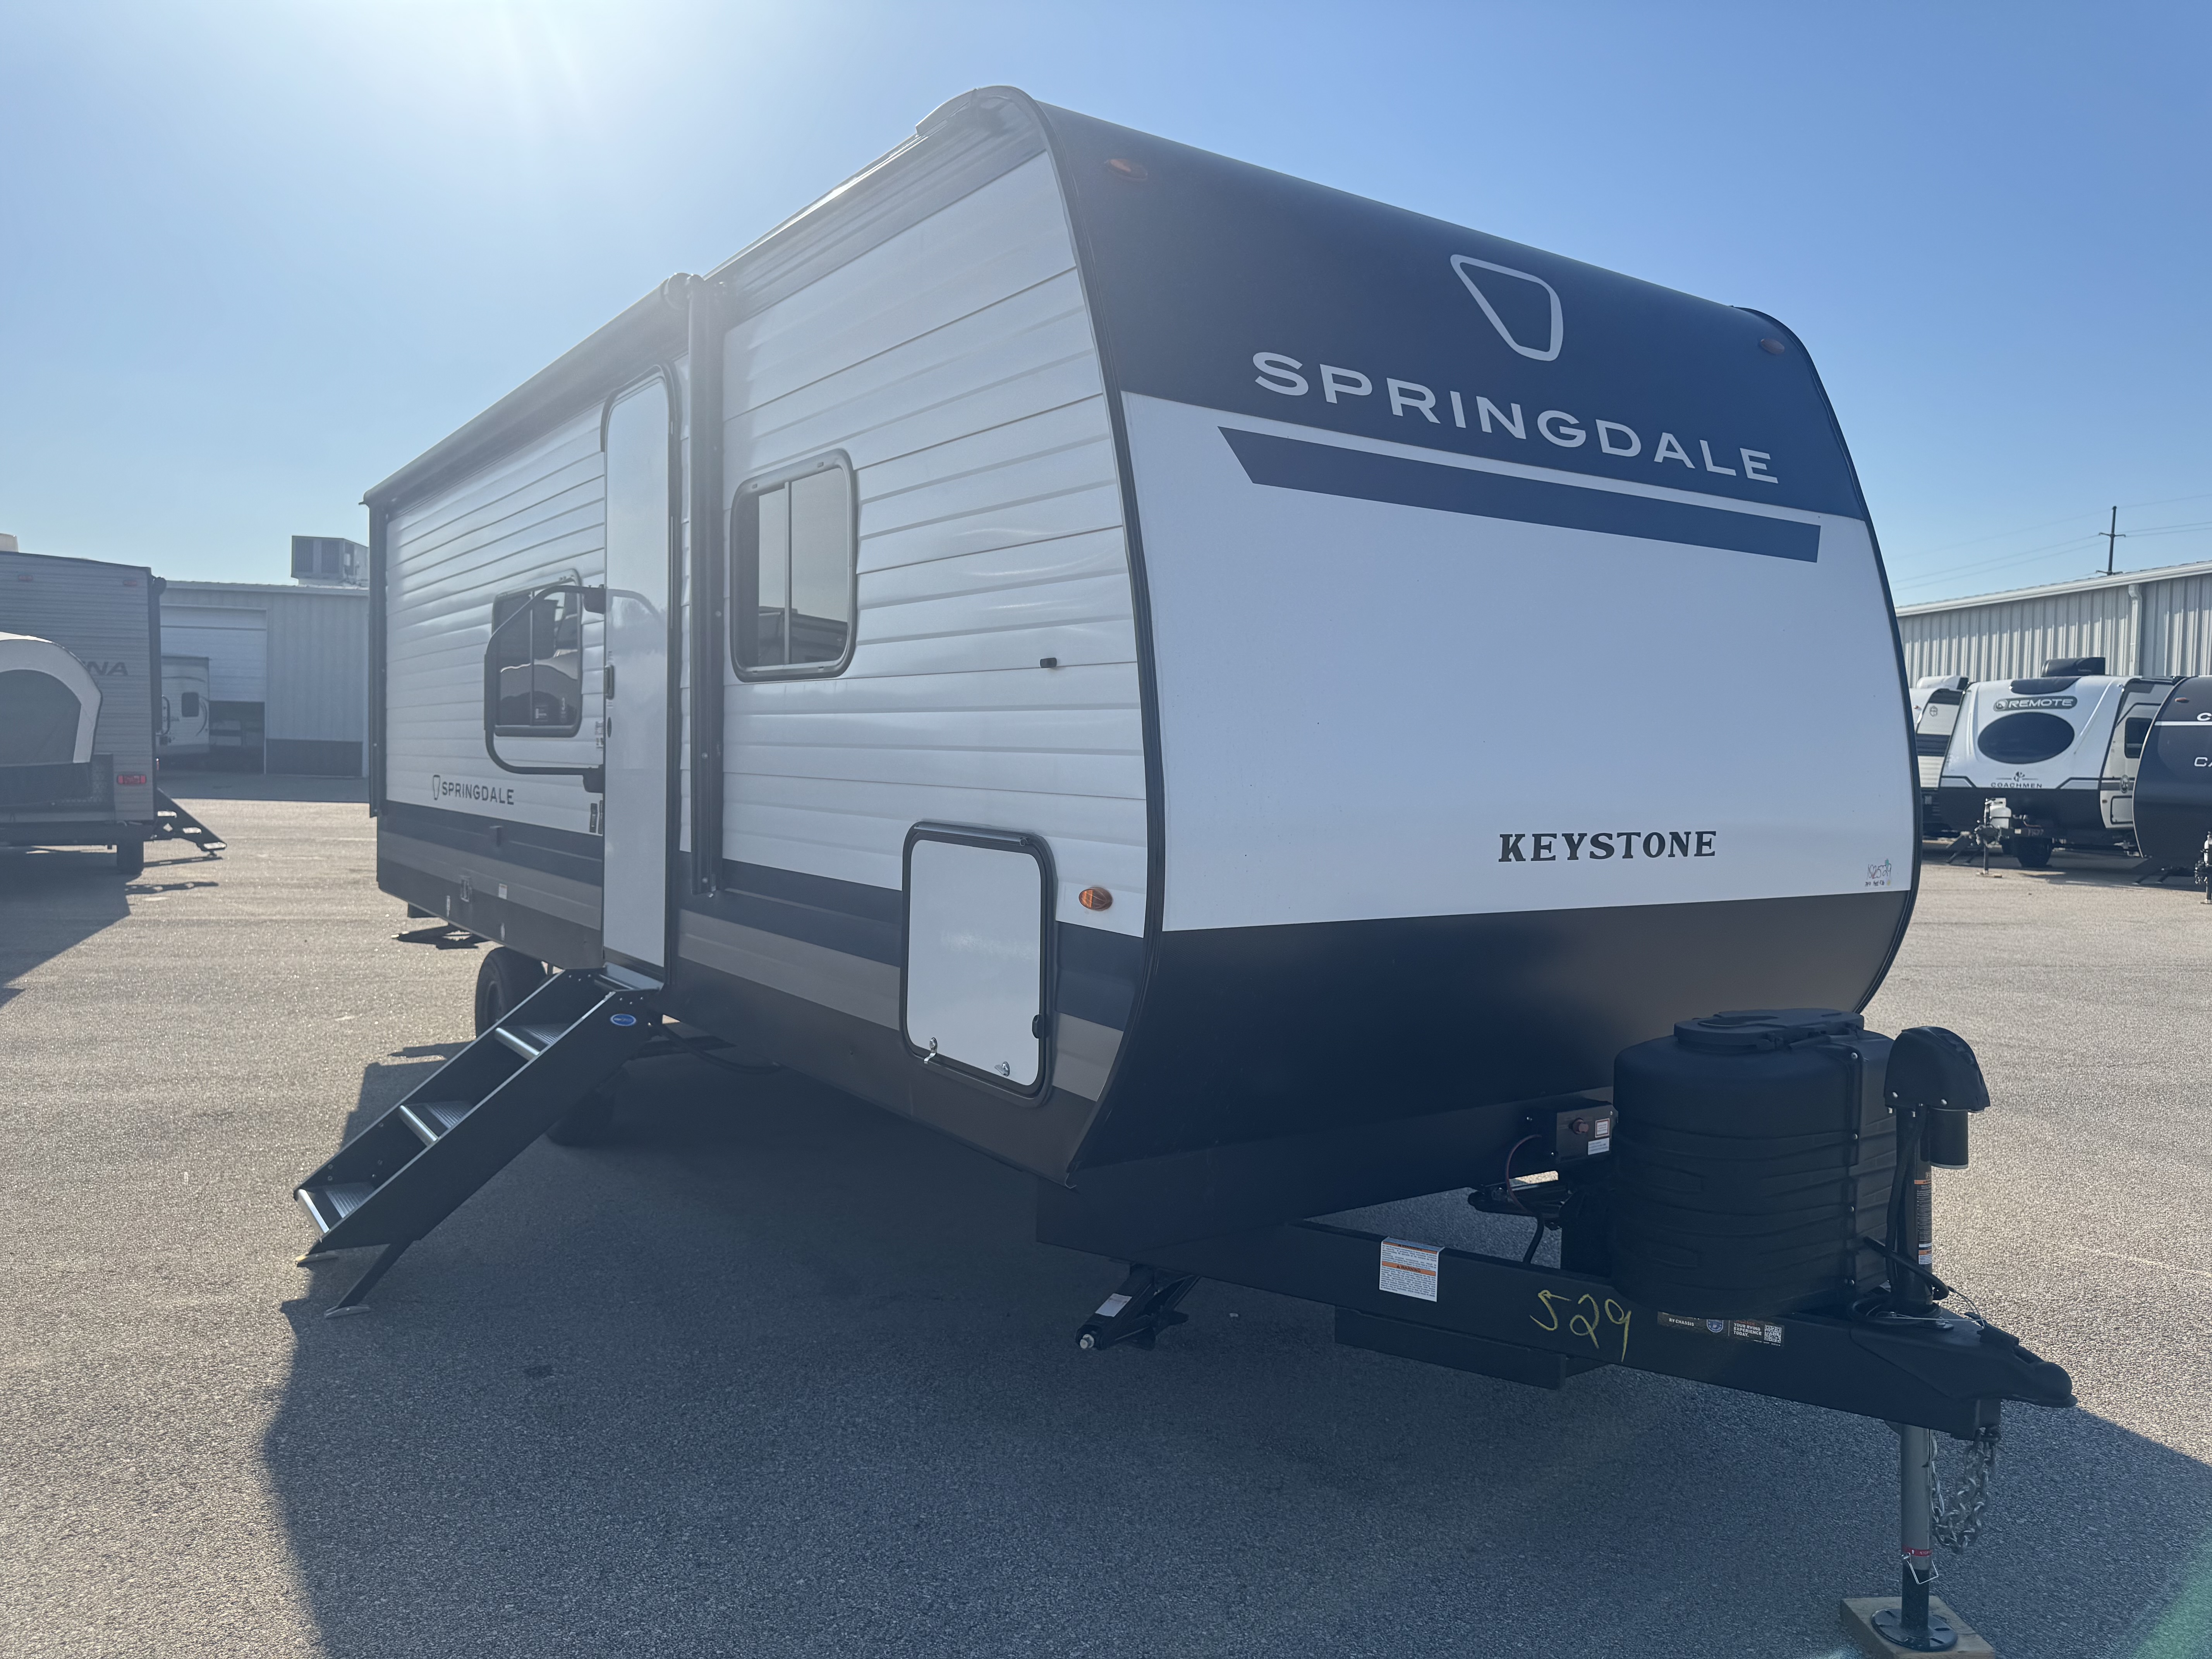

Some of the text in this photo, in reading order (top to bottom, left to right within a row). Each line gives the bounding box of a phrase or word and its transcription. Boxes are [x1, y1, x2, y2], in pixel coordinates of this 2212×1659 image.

[1252, 351, 1779, 484] SPRINGDALE
[2008, 698, 2073, 708] REMOTE
[2194, 757, 2212, 767] C
[441, 781, 515, 805] SPRINGDALE
[1498, 831, 1716, 862] KEYSTONE
[1733, 1327, 1762, 1336] EXPERIENCE
